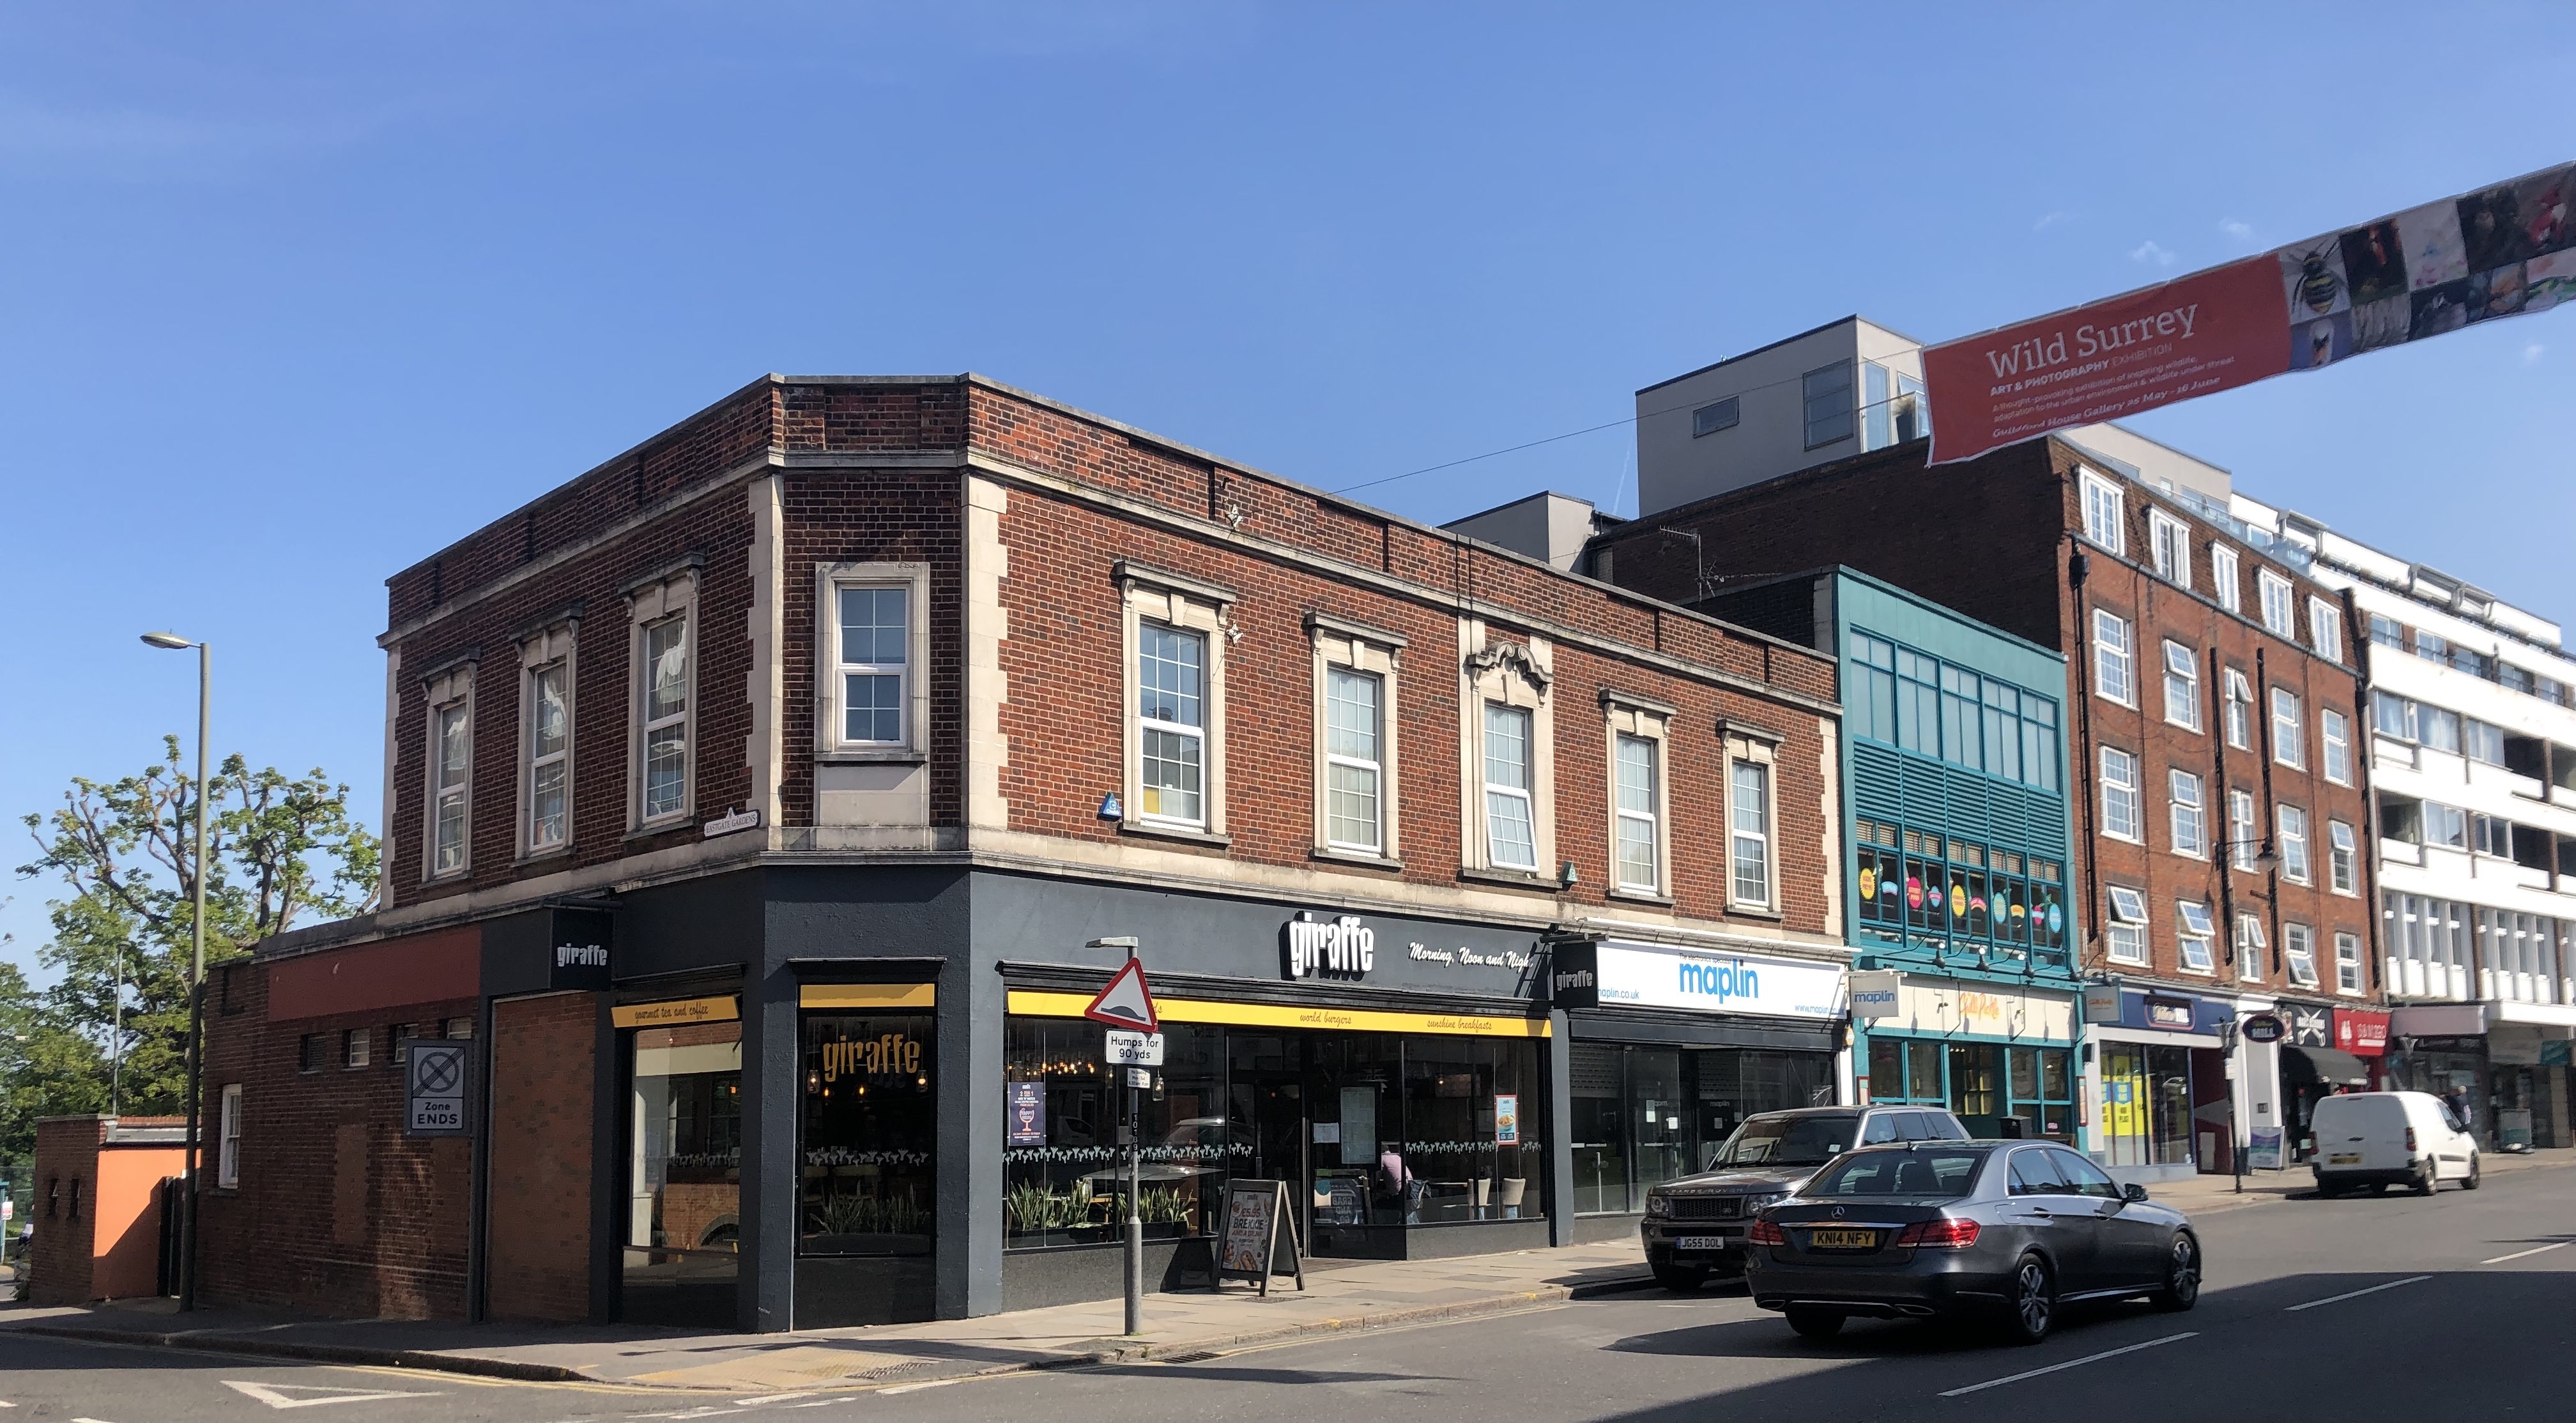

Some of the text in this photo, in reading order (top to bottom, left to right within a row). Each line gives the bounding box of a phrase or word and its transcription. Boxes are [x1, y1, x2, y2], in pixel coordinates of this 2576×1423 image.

[1986, 303, 2198, 379] Wild Surrey
[1990, 342, 2172, 396] ART & PHOTOGRAPHY EXHIBITION
[2075, 377, 2115, 393] exhibition
[1993, 420, 2046, 438] Guildford
[2047, 413, 2082, 427] House
[2083, 401, 2126, 419] Gallery
[2142, 390, 2168, 404] May
[2190, 377, 2221, 391] June
[706, 814, 756, 833] EASTGATE GARDENS
[1289, 912, 1374, 977] giraffe
[557, 943, 608, 967] giraffe
[1409, 941, 1454, 968] Morning,
[1459, 947, 1483, 965] Noon
[1485, 952, 1504, 966] and
[1556, 970, 1593, 991] giraffe
[1680, 958, 1758, 1004] maplin
[1855, 990, 1895, 1004] maplin
[634, 1001, 709, 1024] gourmet tea and coffee
[1300, 1011, 1352, 1027] world burgers
[1427, 1017, 1492, 1033] sunshine breakfasts
[1111, 1036, 1159, 1048] Humps for
[823, 1034, 920, 1082] giraffe
[1119, 1048, 1151, 1060] 90 yds
[425, 1102, 450, 1110] Zone
[418, 1113, 458, 1124] ENDS
[1233, 1218, 1264, 1230] BREKKIE
[1682, 1238, 1721, 1247] JG55 DOL
[1817, 1231, 1871, 1245] KN14 NFY
